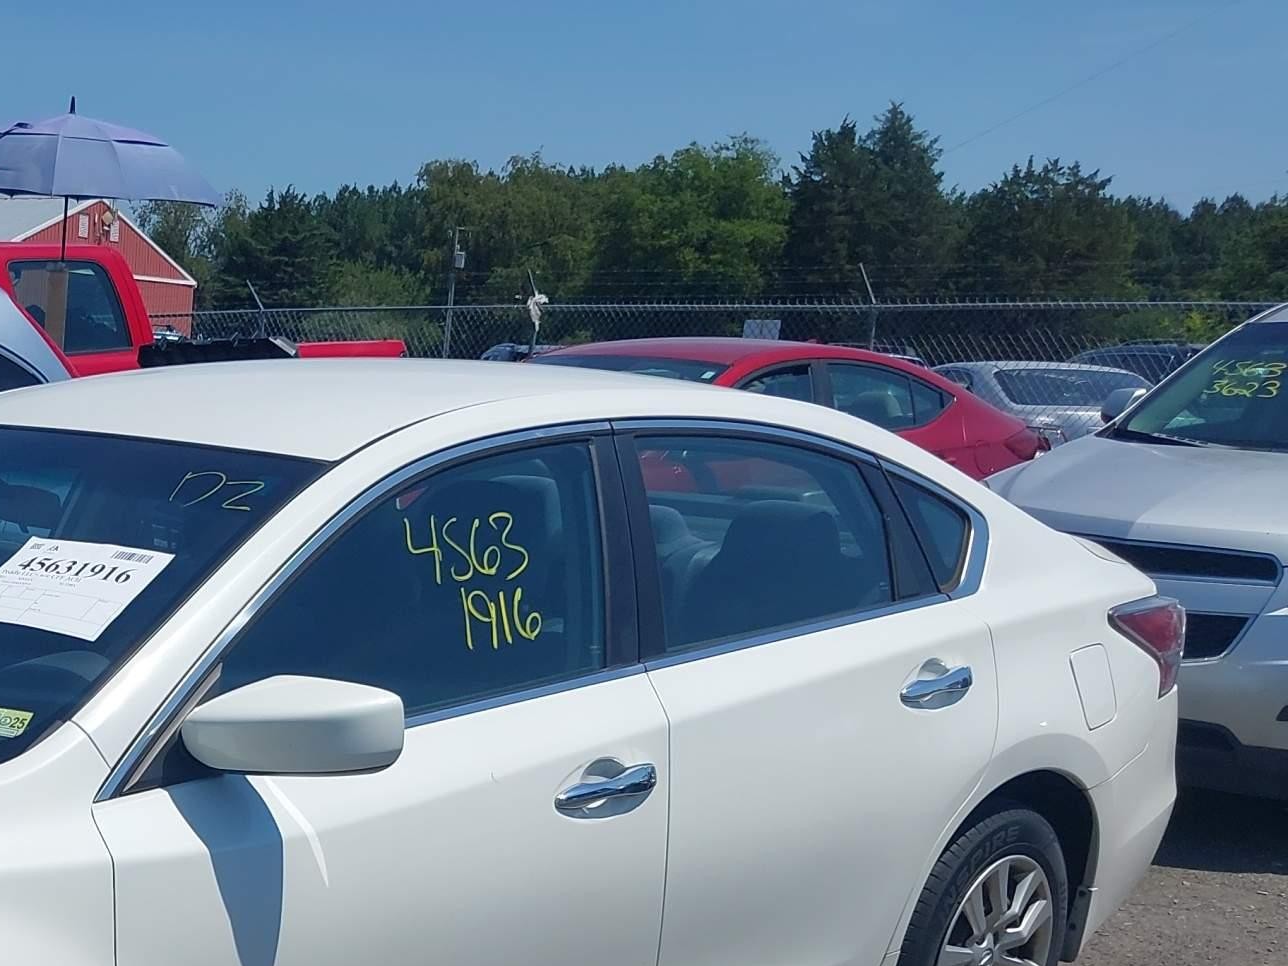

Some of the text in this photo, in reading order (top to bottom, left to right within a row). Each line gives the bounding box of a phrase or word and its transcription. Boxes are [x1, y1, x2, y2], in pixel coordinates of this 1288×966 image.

[1211, 359, 1288, 378] 4563
[1202, 379, 1281, 398] 3623
[403, 511, 530, 585] 4563
[17, 556, 138, 585] 45631916
[460, 586, 543, 650] 1916
[9, 716, 28, 729] 25
